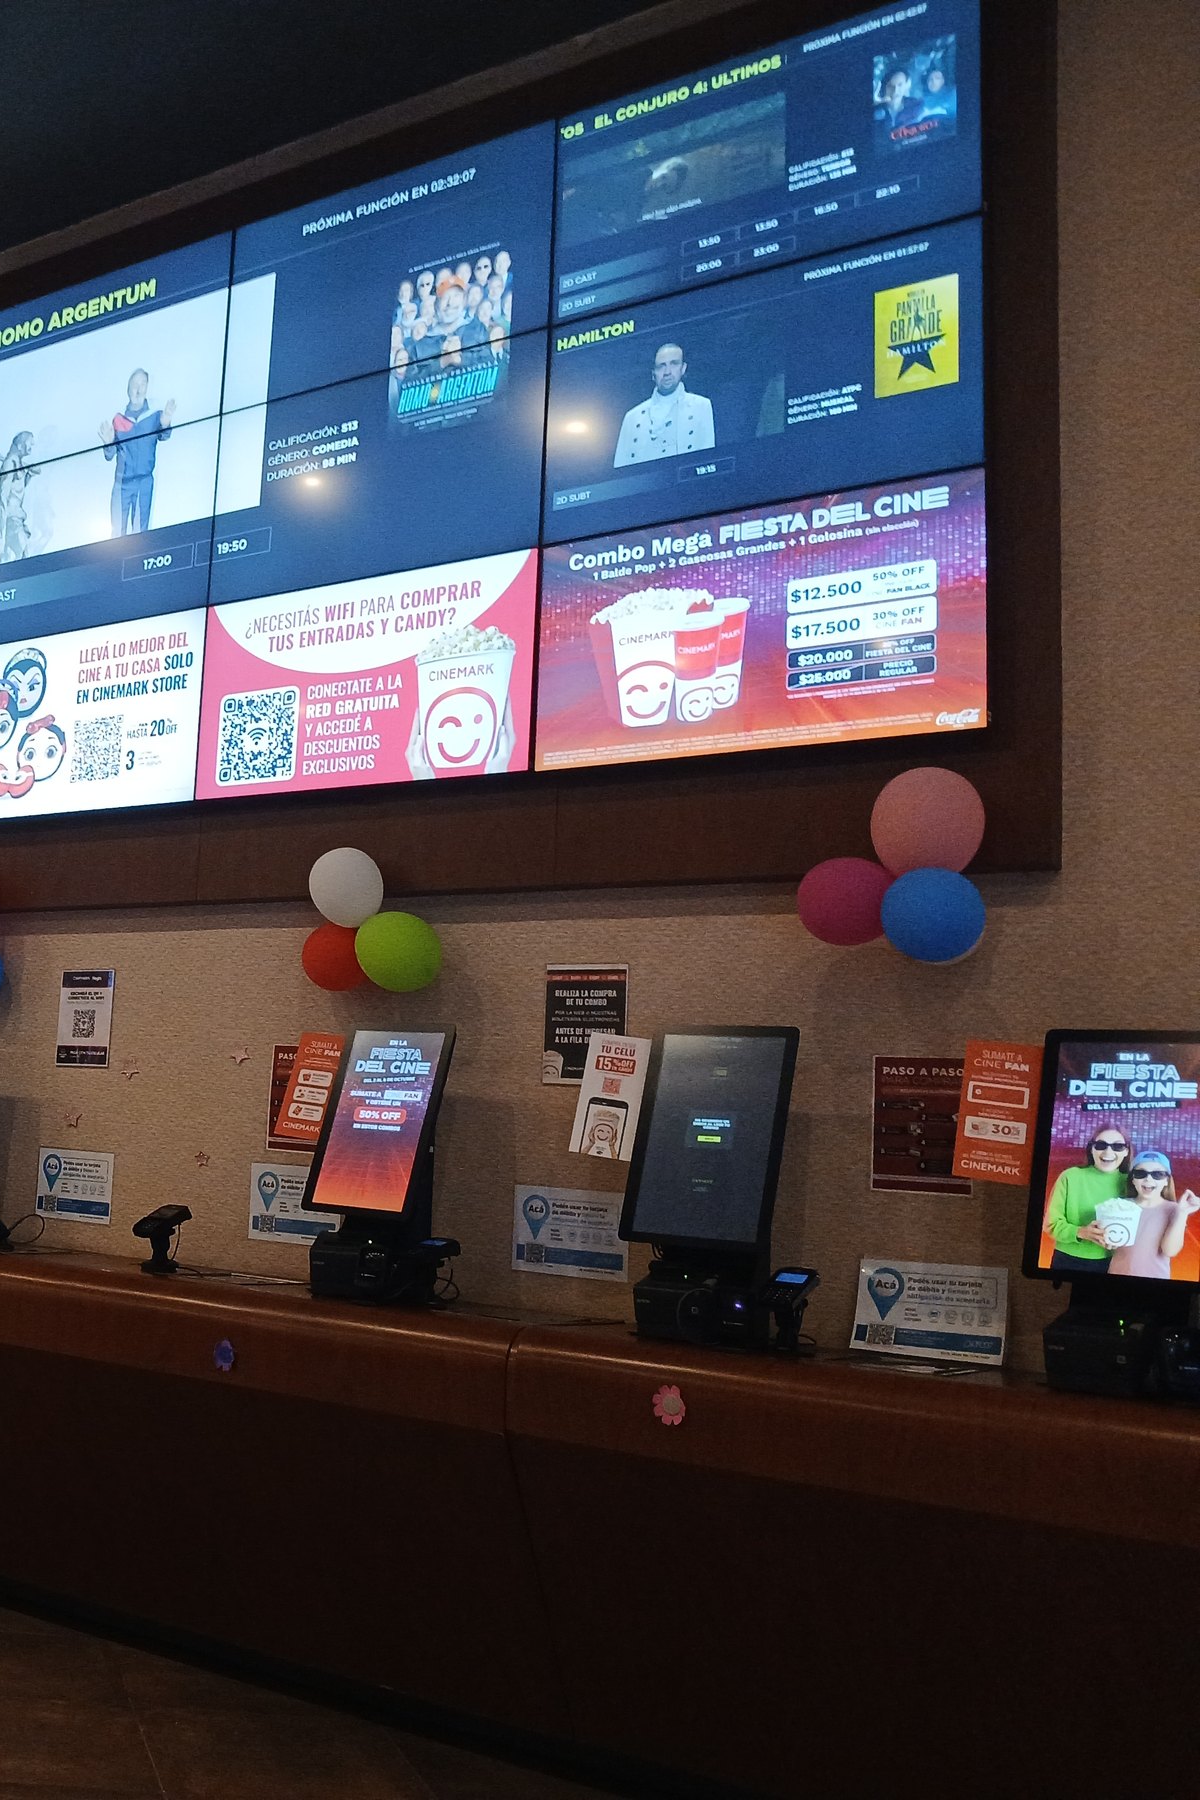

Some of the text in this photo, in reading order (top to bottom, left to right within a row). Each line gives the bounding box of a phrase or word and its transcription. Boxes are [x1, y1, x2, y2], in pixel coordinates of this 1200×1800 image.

[594, 54, 781, 130] EL CONJURO 4: ULTIMOS
[302, 167, 476, 237] PRÓXIMA FUNCIÓN EN 02:32:07
[803, 250, 896, 281] PRÓXIMA FUNCIÓN EN
[47, 278, 158, 331] ARGENTUM
[557, 320, 635, 351] HAMILTON
[397, 383, 434, 414] HOMO
[437, 367, 499, 403] ARGENTUM
[269, 420, 359, 451] CALIFICACIÓN: S13
[268, 436, 359, 467] GÉNERO: COMEDIA
[267, 461, 320, 482] DURACIÓN:
[336, 452, 357, 466] MIN
[569, 490, 591, 503] SUBT
[569, 486, 950, 572] Combo Mega FIESTA DEL CINE
[216, 538, 248, 554] 19:50
[600, 526, 863, 581] Balde Pop Gaseosas Grandes Golosina
[142, 554, 173, 570] 17:00
[790, 566, 925, 604] $12.500 50% OFF
[245, 580, 482, 640] ¿NECESITÁS WIFI PARA COMPRAR
[791, 606, 925, 640] $17.500 30% OFF
[901, 616, 922, 626] FAN
[268, 607, 457, 653] TUS ENTRADAS Y CANDY?
[619, 630, 675, 646] CINEMARK
[79, 632, 189, 664] LLEVÁ LO MEJOR DEL
[912, 642, 933, 653] CINE
[797, 649, 853, 667] $20.000
[883, 659, 914, 669] PRECIO
[77, 652, 194, 685] CINE A TU CASA SOLO
[428, 663, 495, 683] CINEMARK
[879, 666, 918, 677] REGULAR
[76, 673, 188, 705] EN CINEMARK STORE
[306, 673, 403, 701] CONECTATE A LA
[306, 693, 400, 719] RED GRATUITA
[150, 718, 165, 737] 20
[305, 714, 374, 738] Y ACCEDÉ A
[303, 735, 381, 757] DESCUENTOS
[125, 749, 135, 771] 3
[302, 754, 376, 776] EXCLUSIVOS
[555, 989, 617, 998] REALIZA COMPRA
[584, 998, 607, 1006] COMBO
[569, 1036, 582, 1044] FILA
[324, 1049, 341, 1057] FAN
[370, 1047, 422, 1060] FIESTA
[601, 1045, 636, 1057] TU CELU
[982, 1050, 1015, 1061] SUMATE
[1119, 1053, 1150, 1062] EN LA
[355, 1060, 431, 1075] DEL CINE
[598, 1056, 612, 1070] 15
[882, 1066, 964, 1077] PASO A PASO
[973, 1058, 1030, 1073] CINE FAN
[1090, 1063, 1180, 1080] FIESTA
[1069, 1080, 1198, 1099] DEL CINE
[359, 1109, 401, 1120] 50% OFF
[282, 1121, 320, 1133] CINEMARK
[992, 1123, 1012, 1136] 30
[960, 1159, 1020, 1176] CINEMARK
[262, 1180, 275, 1188] Acá
[528, 1204, 544, 1213] Acá
[875, 1278, 897, 1290] Acá
